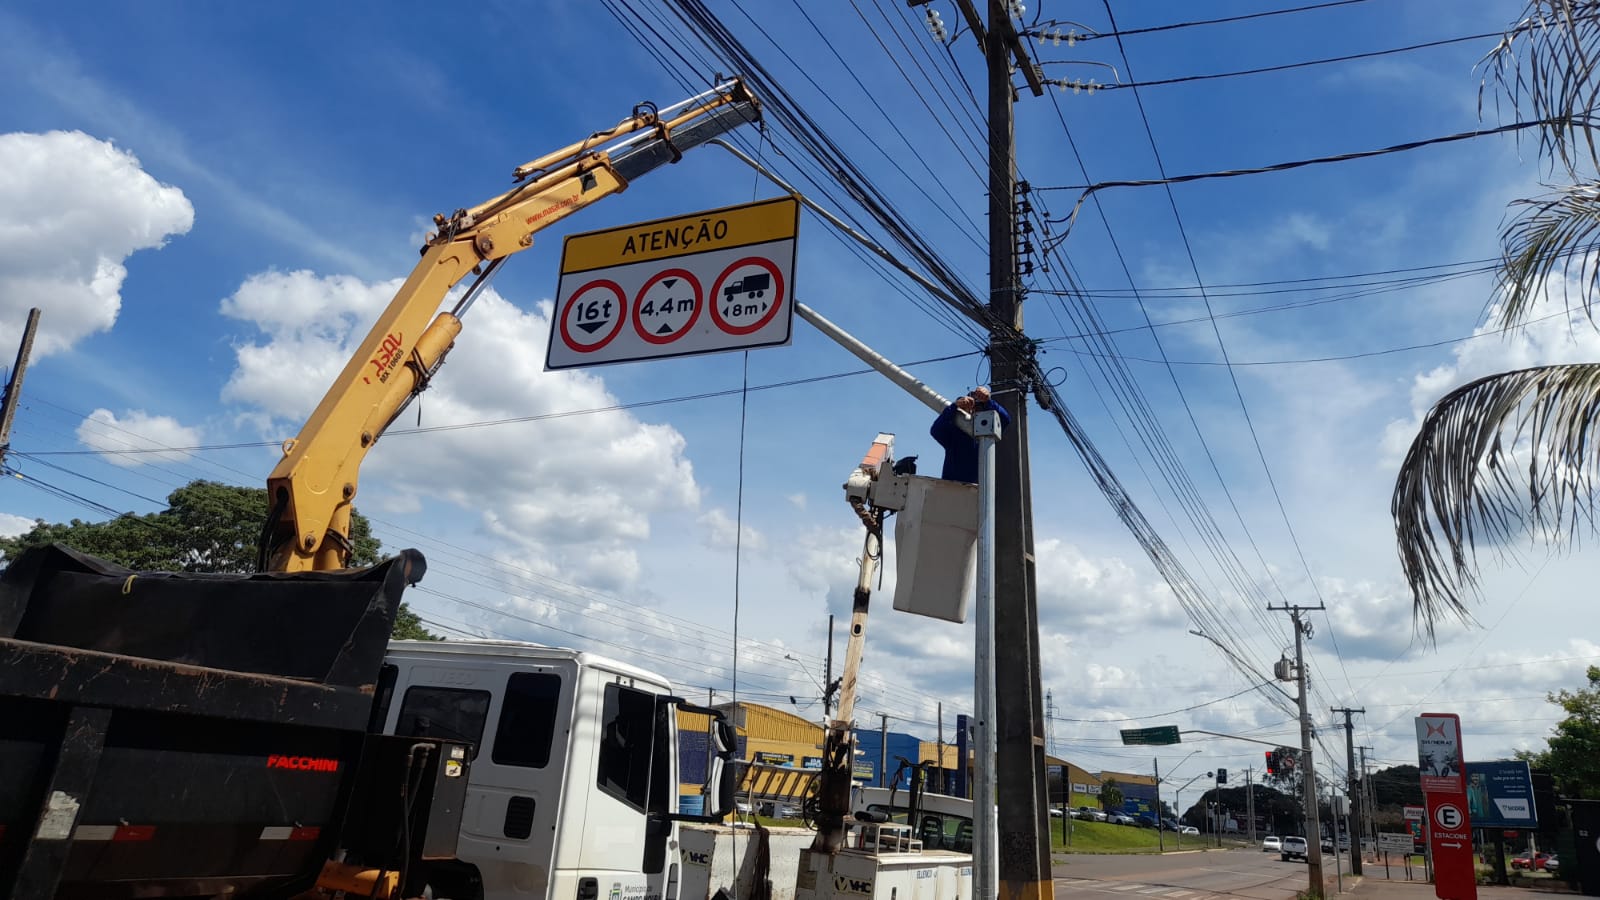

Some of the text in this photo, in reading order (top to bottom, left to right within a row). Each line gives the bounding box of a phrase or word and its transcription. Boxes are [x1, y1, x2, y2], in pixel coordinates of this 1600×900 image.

[622, 218, 728, 256] ATENÇÃO
[577, 299, 612, 322] 16t
[732, 303, 758, 317] 8m
[266, 754, 339, 772] FACCHINI
[1442, 808, 1456, 825] E
[1434, 832, 1467, 840] ESTACIONE
[689, 851, 709, 864] VHC
[850, 880, 872, 894] VHC
